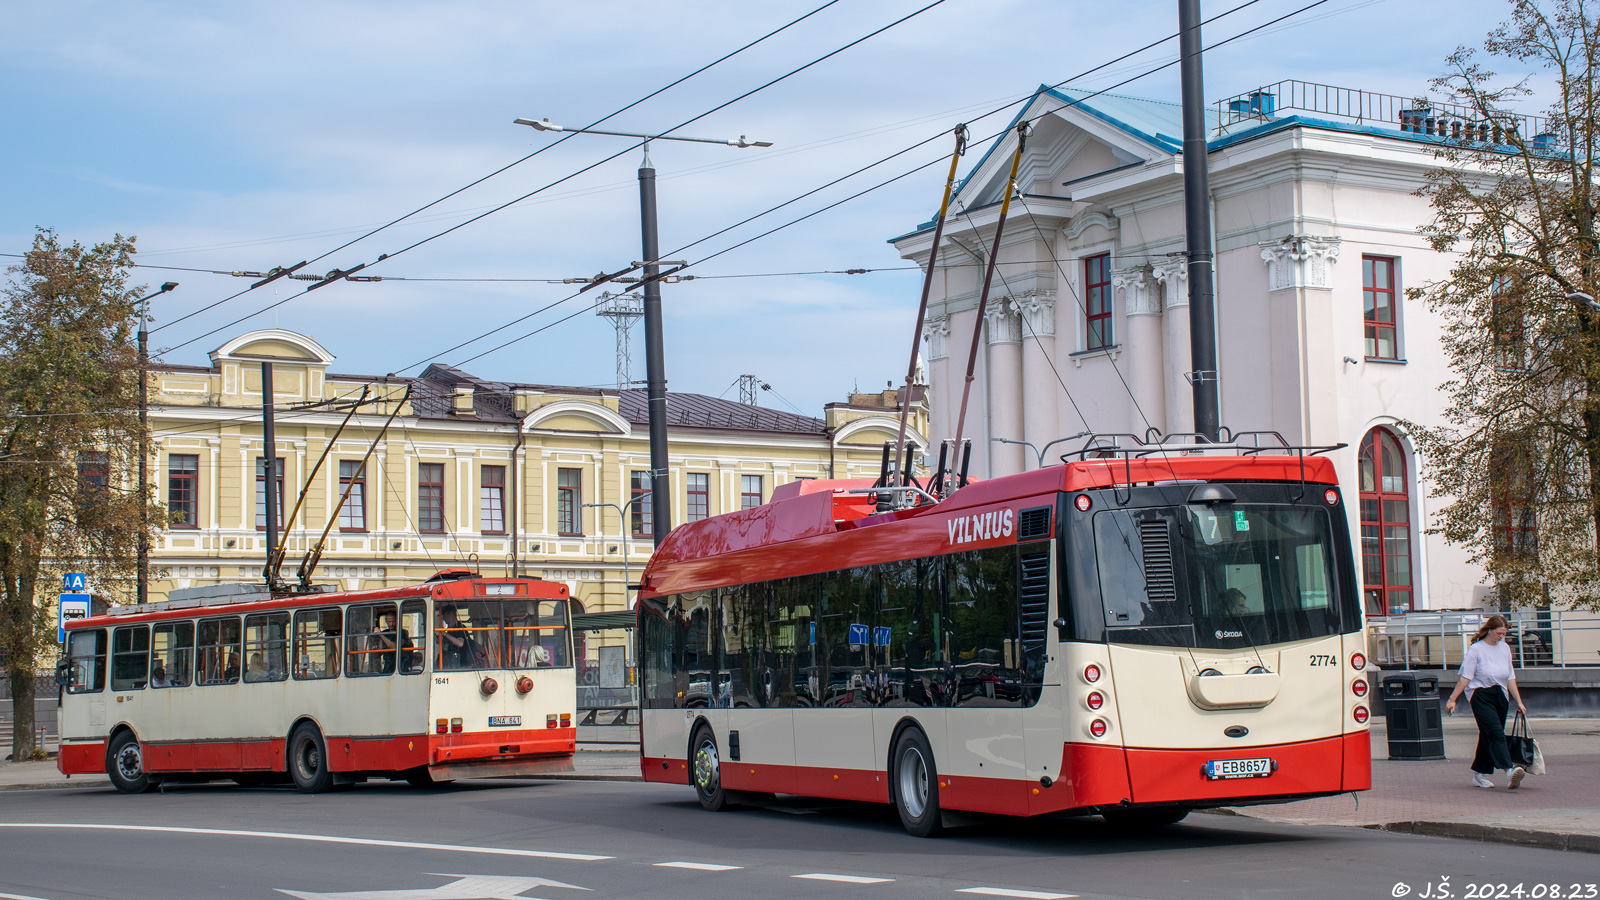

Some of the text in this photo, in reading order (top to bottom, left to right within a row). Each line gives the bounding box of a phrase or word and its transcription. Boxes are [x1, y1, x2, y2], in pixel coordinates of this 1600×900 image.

[947, 508, 1013, 545] VILNIUS
[1207, 515, 1218, 539] 7
[64, 576, 71, 588] A
[71, 575, 83, 588] A
[497, 584, 502, 593] 2
[1223, 630, 1243, 638] ŠKODA
[1309, 655, 1337, 667] 2774
[434, 677, 449, 685] 1641
[509, 716, 520, 724] 641
[1222, 760, 1267, 774] EB8657
